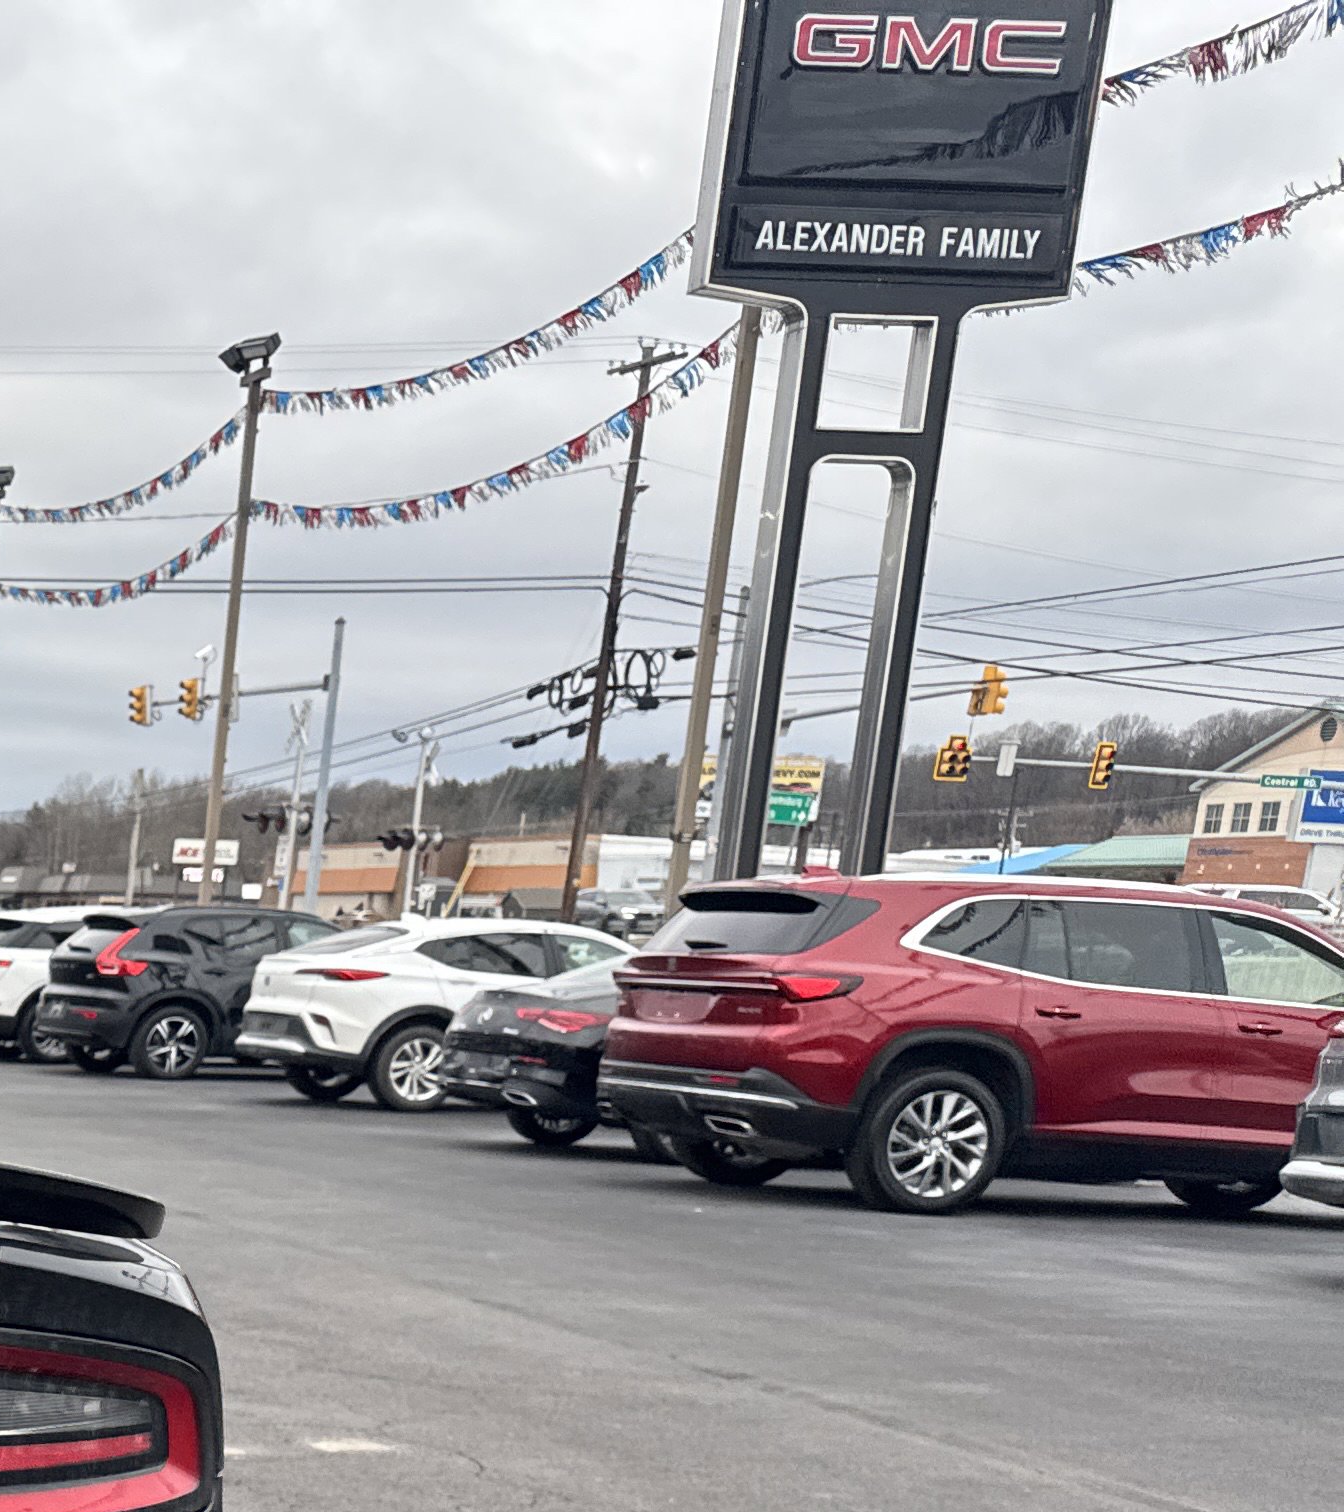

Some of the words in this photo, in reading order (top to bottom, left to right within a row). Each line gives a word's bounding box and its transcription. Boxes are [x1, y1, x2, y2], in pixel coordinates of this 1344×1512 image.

[793, 13, 1067, 75] GMC
[755, 220, 925, 257] ALEXANDER
[939, 226, 1041, 260] FAMILY
[1264, 776, 1299, 787] Central
